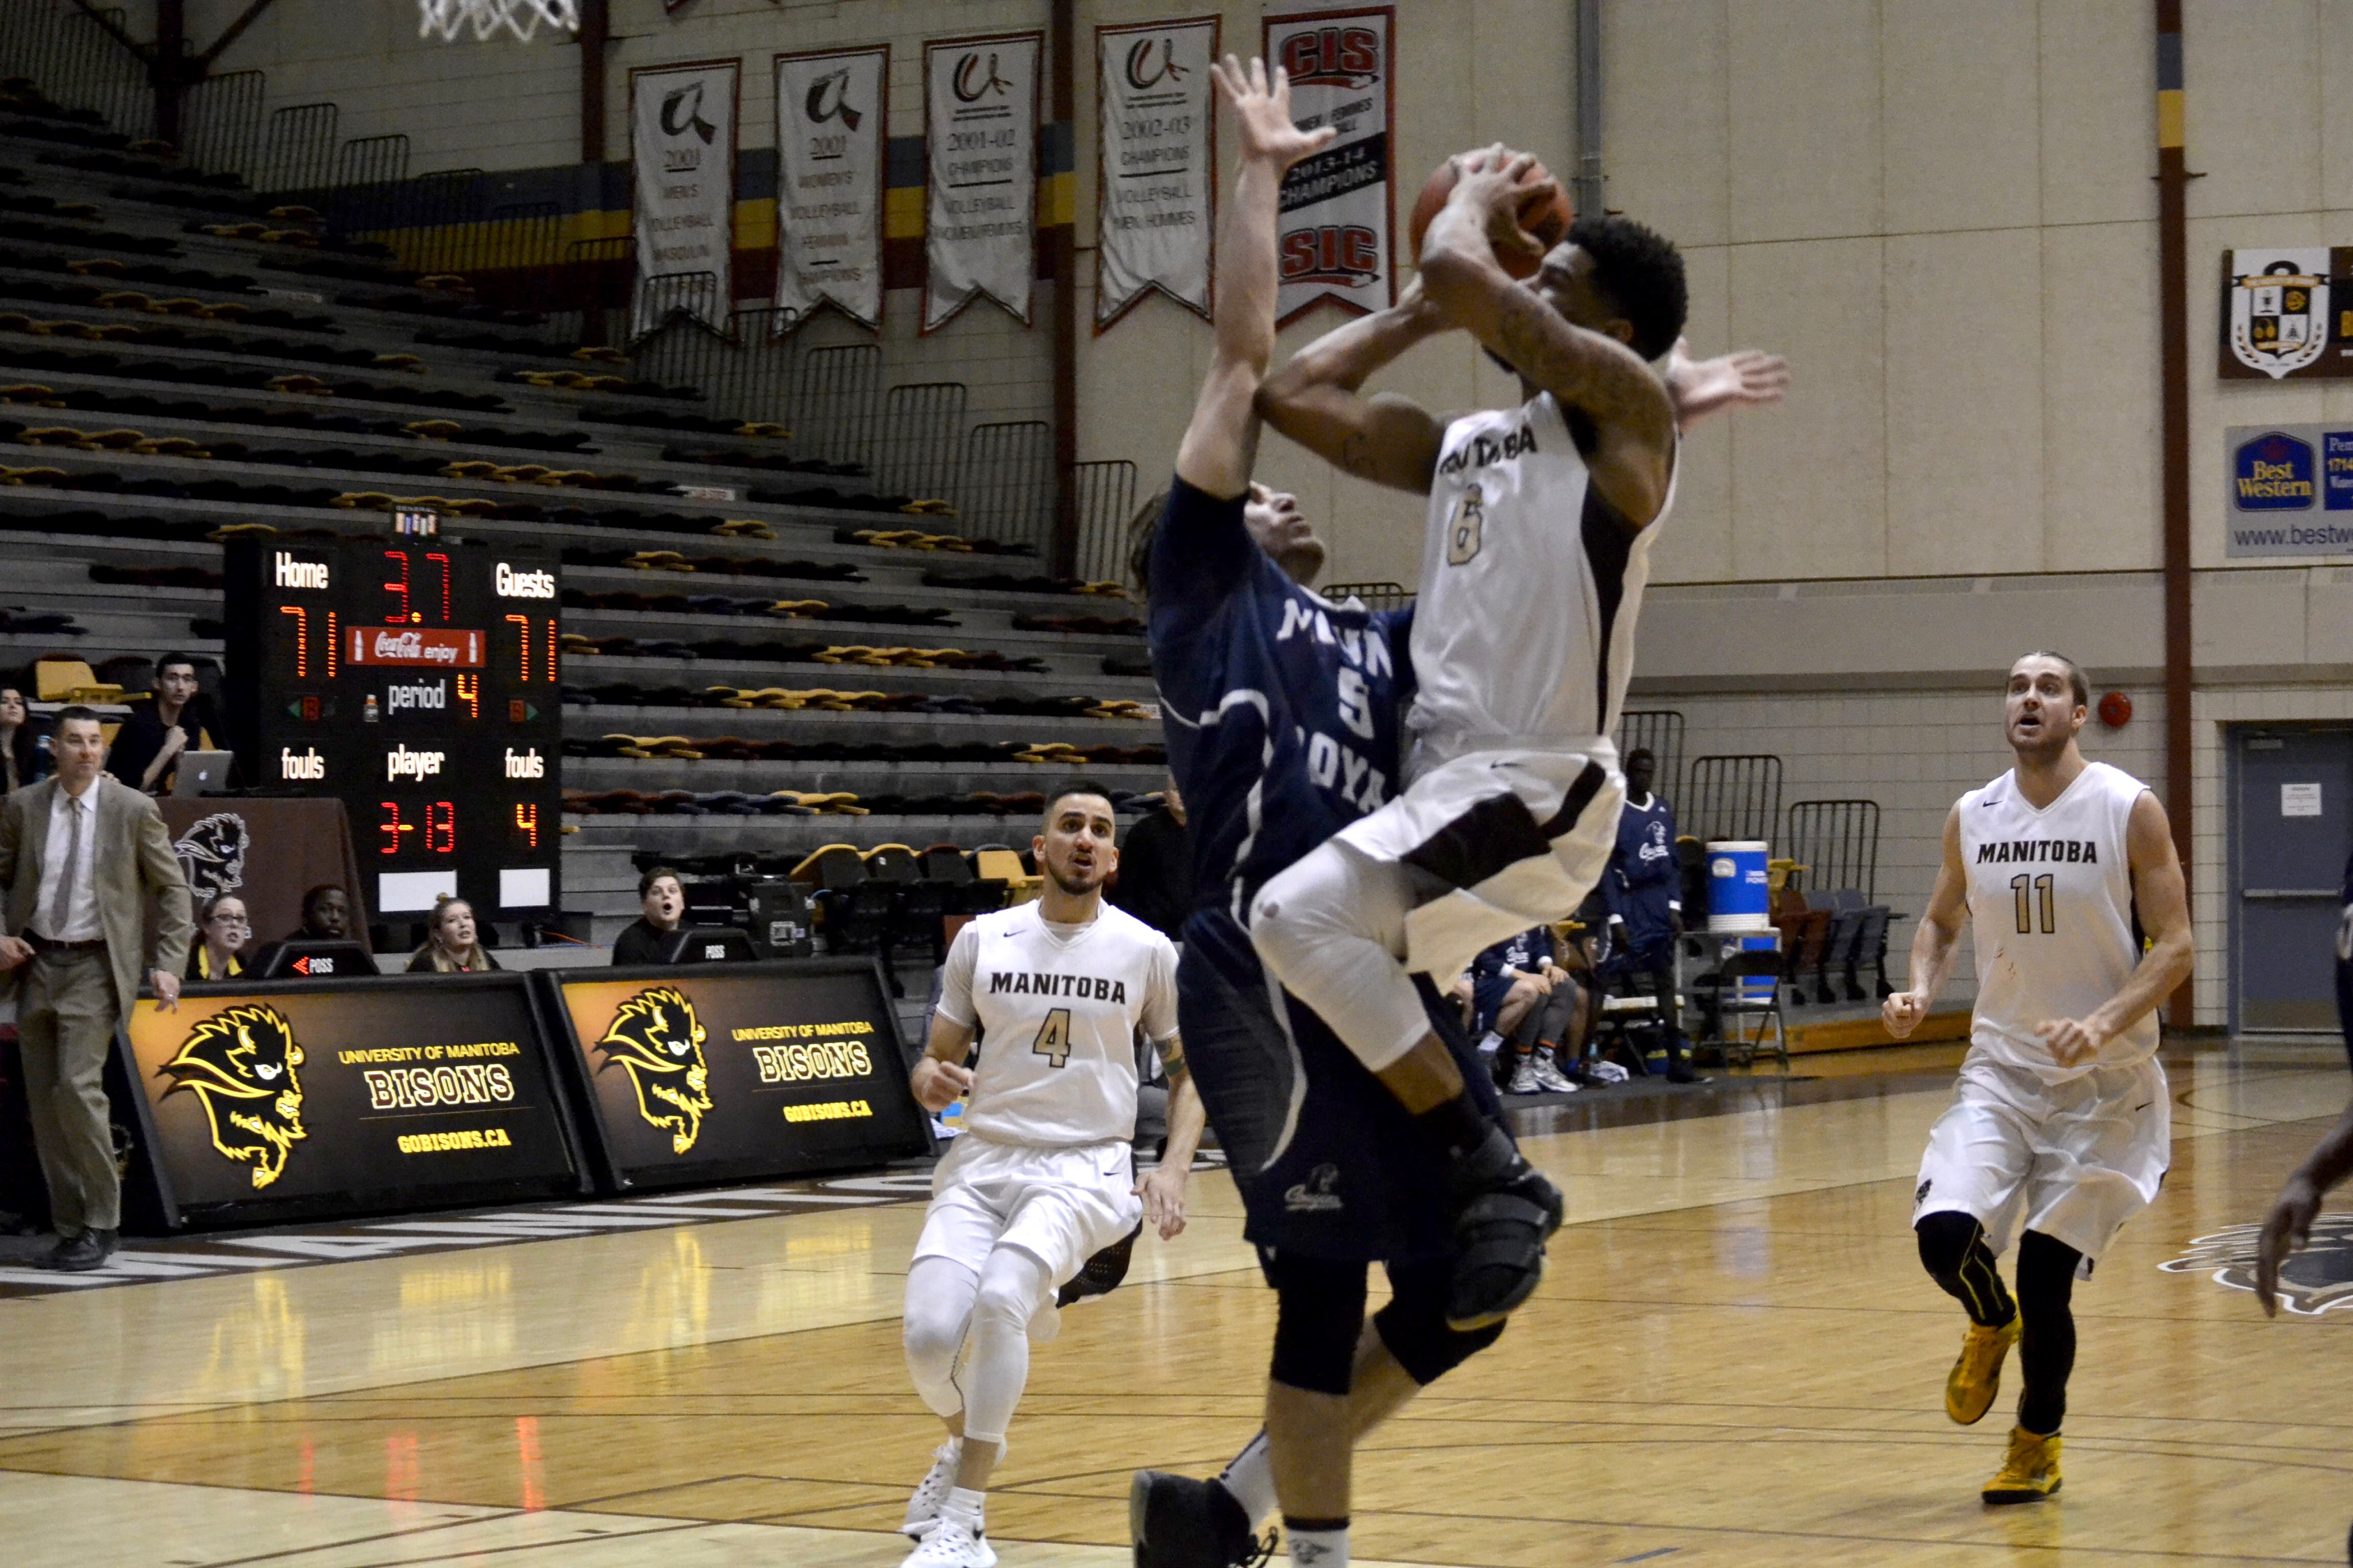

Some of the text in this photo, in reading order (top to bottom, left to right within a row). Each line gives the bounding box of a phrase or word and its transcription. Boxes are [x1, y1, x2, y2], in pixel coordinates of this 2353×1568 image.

[1279, 26, 1379, 79] CIS
[1280, 225, 1378, 278] SIC
[2238, 478, 2312, 497] Western
[2253, 460, 2294, 480] Best
[275, 551, 329, 589] Home
[496, 562, 555, 599] Guests
[280, 606, 337, 678] 71
[424, 643, 459, 664] enjoy
[505, 614, 557, 682] 71
[388, 678, 446, 716] period
[458, 674, 479, 719] 4
[1338, 665, 1375, 740] 5
[281, 747, 325, 780] fouls
[388, 744, 445, 782] player
[505, 747, 544, 779] fouls
[516, 804, 536, 848] 4
[1977, 839, 2097, 864] MANITOBA
[2010, 873, 2055, 934] 11
[309, 958, 334, 974] POSS
[705, 944, 725, 959] POSS
[989, 972, 1126, 1005] MANITOBA
[731, 1021, 874, 1042] UNIVERSITY OF MANITOBA
[1032, 1007, 1071, 1068] 4
[338, 1042, 520, 1065] UNIVERSITY OF MANITOBA
[752, 1041, 873, 1083] BISONS
[364, 1064, 515, 1110] BISONS
[783, 1100, 873, 1123] GOBISONS.CA
[397, 1128, 512, 1154] GOBISONS.CA
